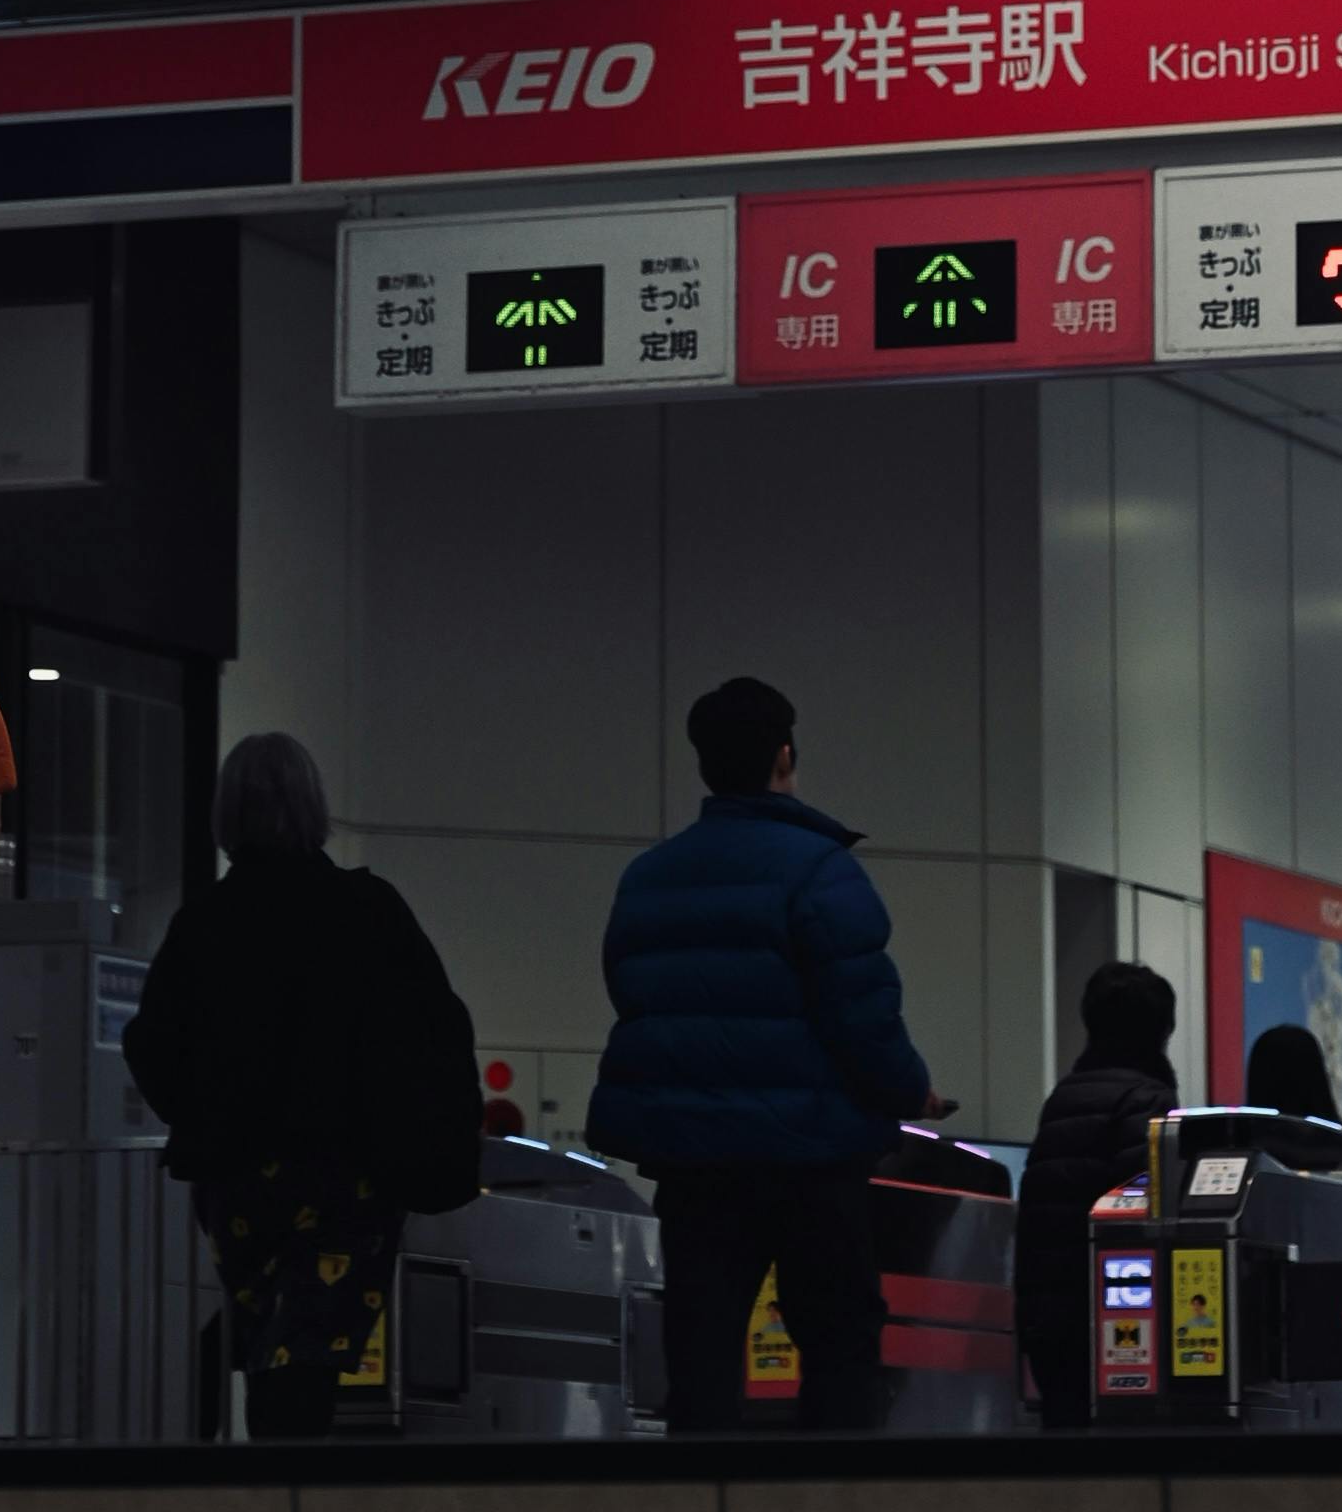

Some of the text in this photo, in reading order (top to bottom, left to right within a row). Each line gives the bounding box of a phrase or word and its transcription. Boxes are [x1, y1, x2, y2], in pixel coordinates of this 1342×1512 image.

[734, 0, 1087, 109] 吉祥寺駅
[1148, 33, 1320, 83] Kichijōji
[421, 42, 657, 120] KEIO
[779, 252, 838, 300] IC
[1055, 235, 1115, 284] IC
[1199, 246, 1262, 279] きっぷ
[775, 314, 840, 351] 専用
[1052, 297, 1117, 335] 専用
[1199, 297, 1261, 330] 定期
[377, 345, 433, 378] 定期
[639, 330, 698, 362] 定期
[1105, 1260, 1153, 1307] IC
